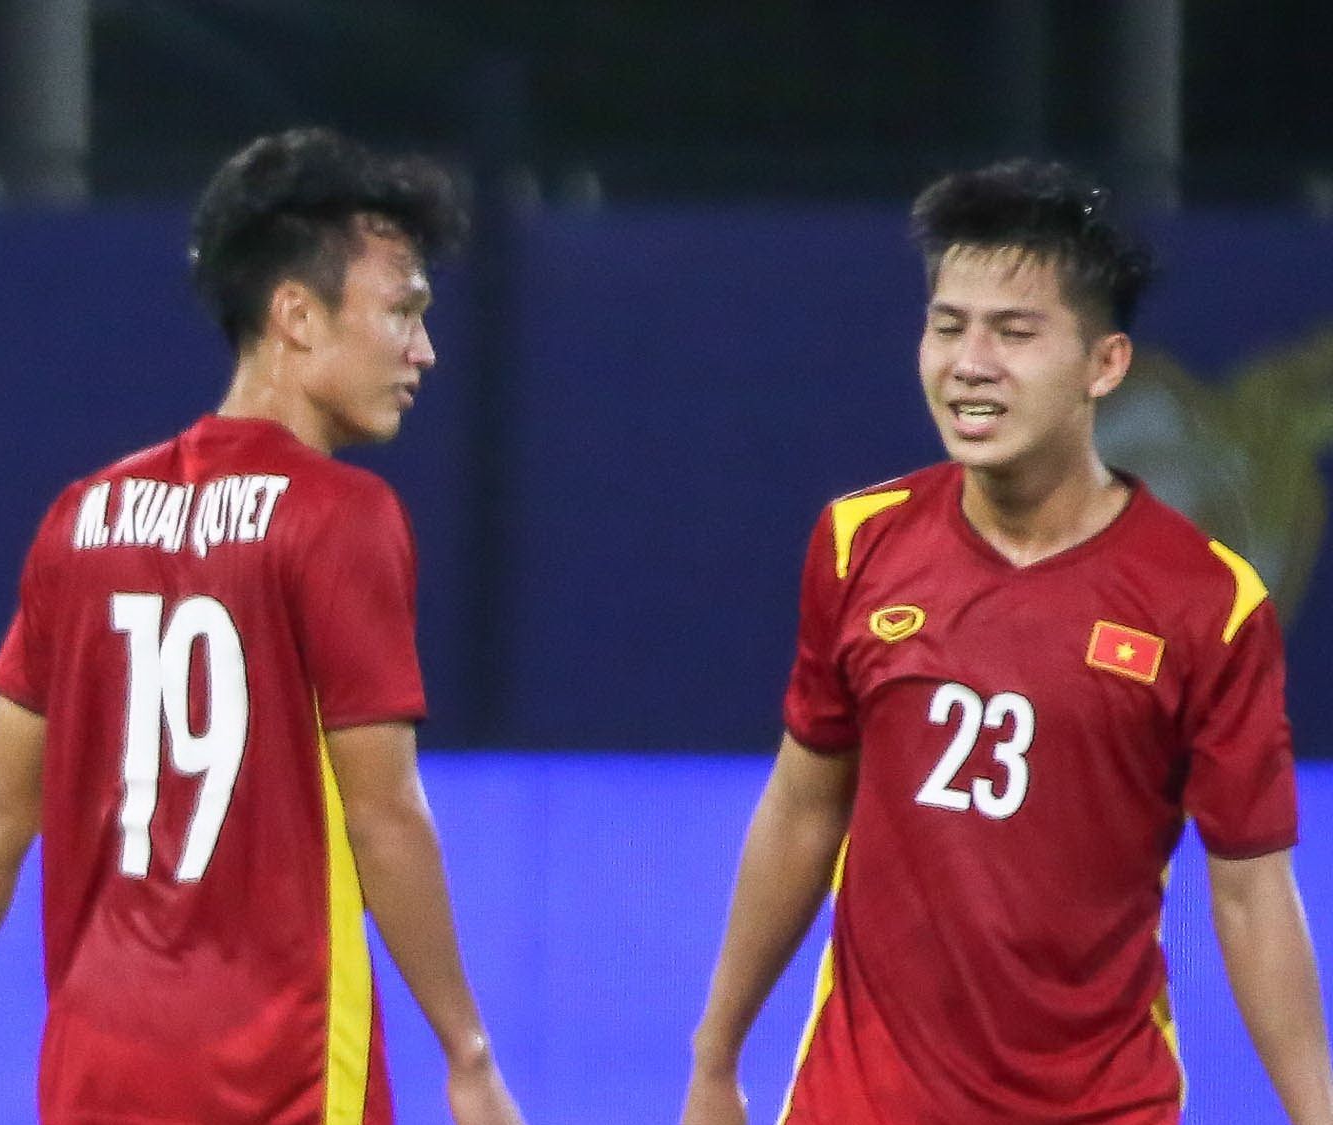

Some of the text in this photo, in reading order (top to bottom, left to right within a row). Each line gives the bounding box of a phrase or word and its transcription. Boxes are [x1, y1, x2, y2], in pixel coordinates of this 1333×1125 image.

[73, 481, 111, 550] M.
[192, 474, 290, 560] QUYET
[110, 592, 249, 882] 19
[913, 681, 1035, 819] 23
